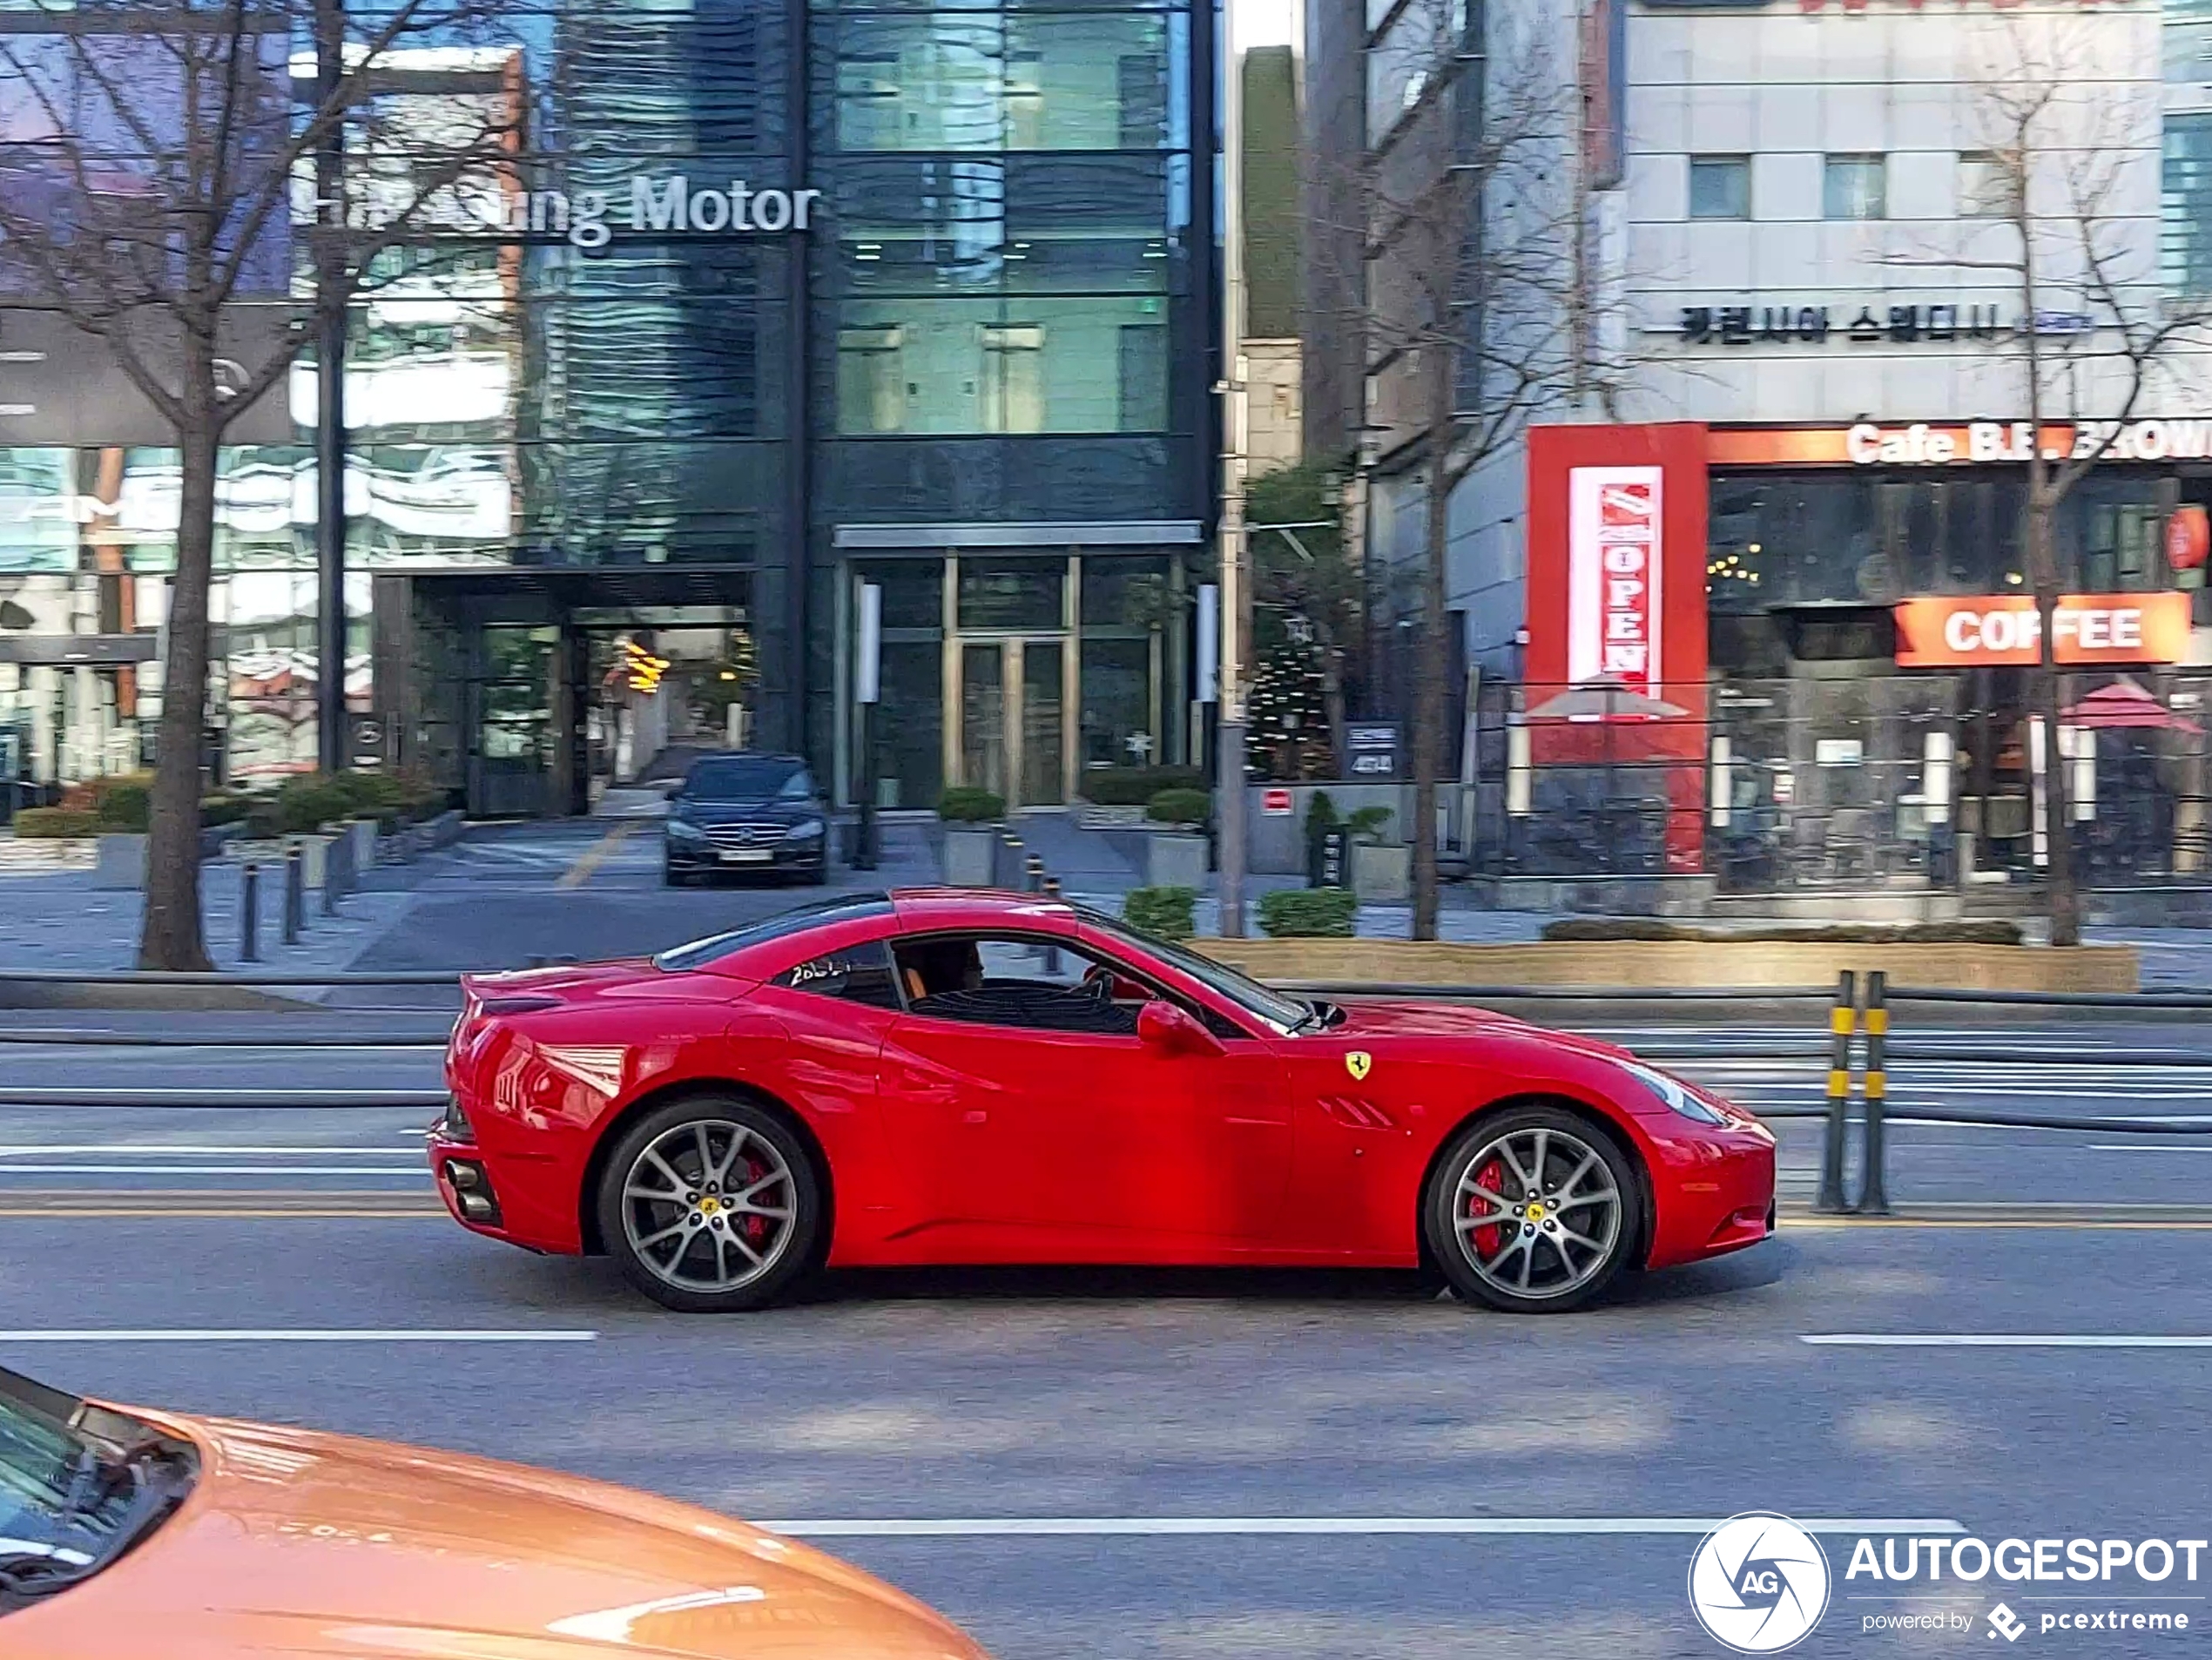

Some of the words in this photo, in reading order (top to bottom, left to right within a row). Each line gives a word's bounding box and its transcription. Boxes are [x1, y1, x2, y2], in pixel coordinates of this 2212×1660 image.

[631, 175, 819, 231] Motor
[1846, 423, 1955, 464] Cafe
[1945, 610, 2141, 651] COFFEE
